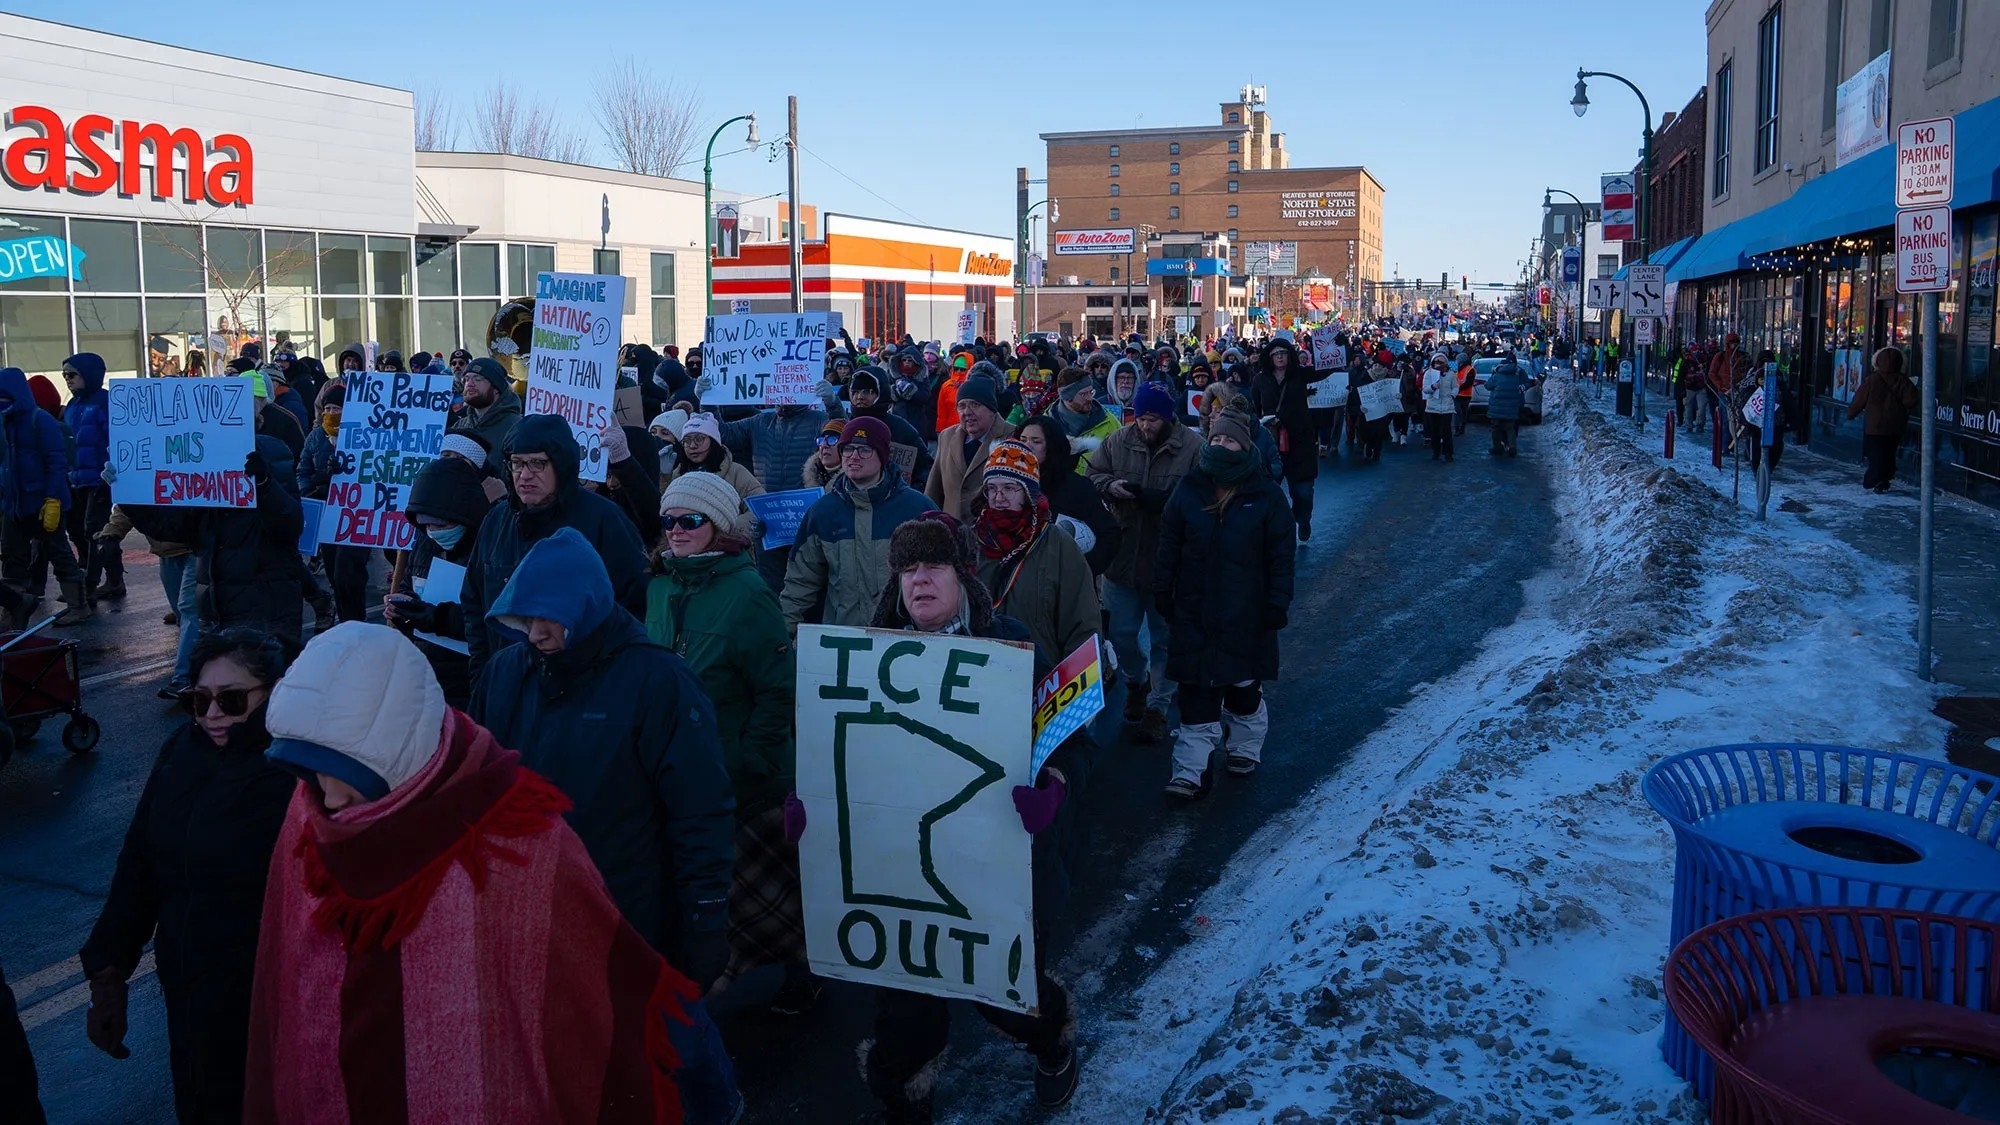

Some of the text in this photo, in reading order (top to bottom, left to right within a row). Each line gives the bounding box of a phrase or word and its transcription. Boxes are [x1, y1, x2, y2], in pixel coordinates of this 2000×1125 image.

[1915, 127, 1935, 144] NO
[1902, 144, 1950, 165] PARKING
[1911, 163, 1940, 176] 1:30 AM
[1904, 175, 1947, 189] TO 6:00 AM
[1282, 209, 1356, 218] MINI STORAGE
[1283, 199, 1356, 208] NORTH STAR
[1914, 215, 1933, 231] NO
[1076, 232, 1131, 243] AutoZone
[1900, 232, 1947, 251] PARKING
[965, 251, 1012, 275] AutoZone
[1914, 252, 1933, 264] BUS
[1910, 264, 1936, 276] STOP
[542, 304, 591, 334] HATING
[706, 317, 739, 343] HOW
[768, 322, 788, 338] WE
[795, 318, 826, 338] HAVE
[1314, 324, 1340, 337] WE ARE
[752, 340, 777, 362] FOR
[782, 340, 823, 362] ICE
[536, 355, 564, 384] MORE
[569, 358, 602, 390] THAN
[774, 363, 809, 373] TEACHERS
[1316, 357, 1344, 368] FAMILY
[774, 373, 813, 384] VETERANS
[346, 372, 451, 412] Mis Padres
[766, 384, 815, 394] HEALTH CARE
[193, 384, 245, 426] VOZ
[528, 387, 607, 431] PEDOPHILES
[1960, 404, 1985, 430] Sierra
[340, 422, 443, 456] TESTAMENTO
[117, 432, 204, 474] DE MIS
[154, 469, 255, 507] ESTUDIANTES
[328, 482, 398, 512] NO DE
[764, 512, 785, 520] WITH
[818, 634, 990, 715] ICE
[1044, 672, 1088, 726] ICE
